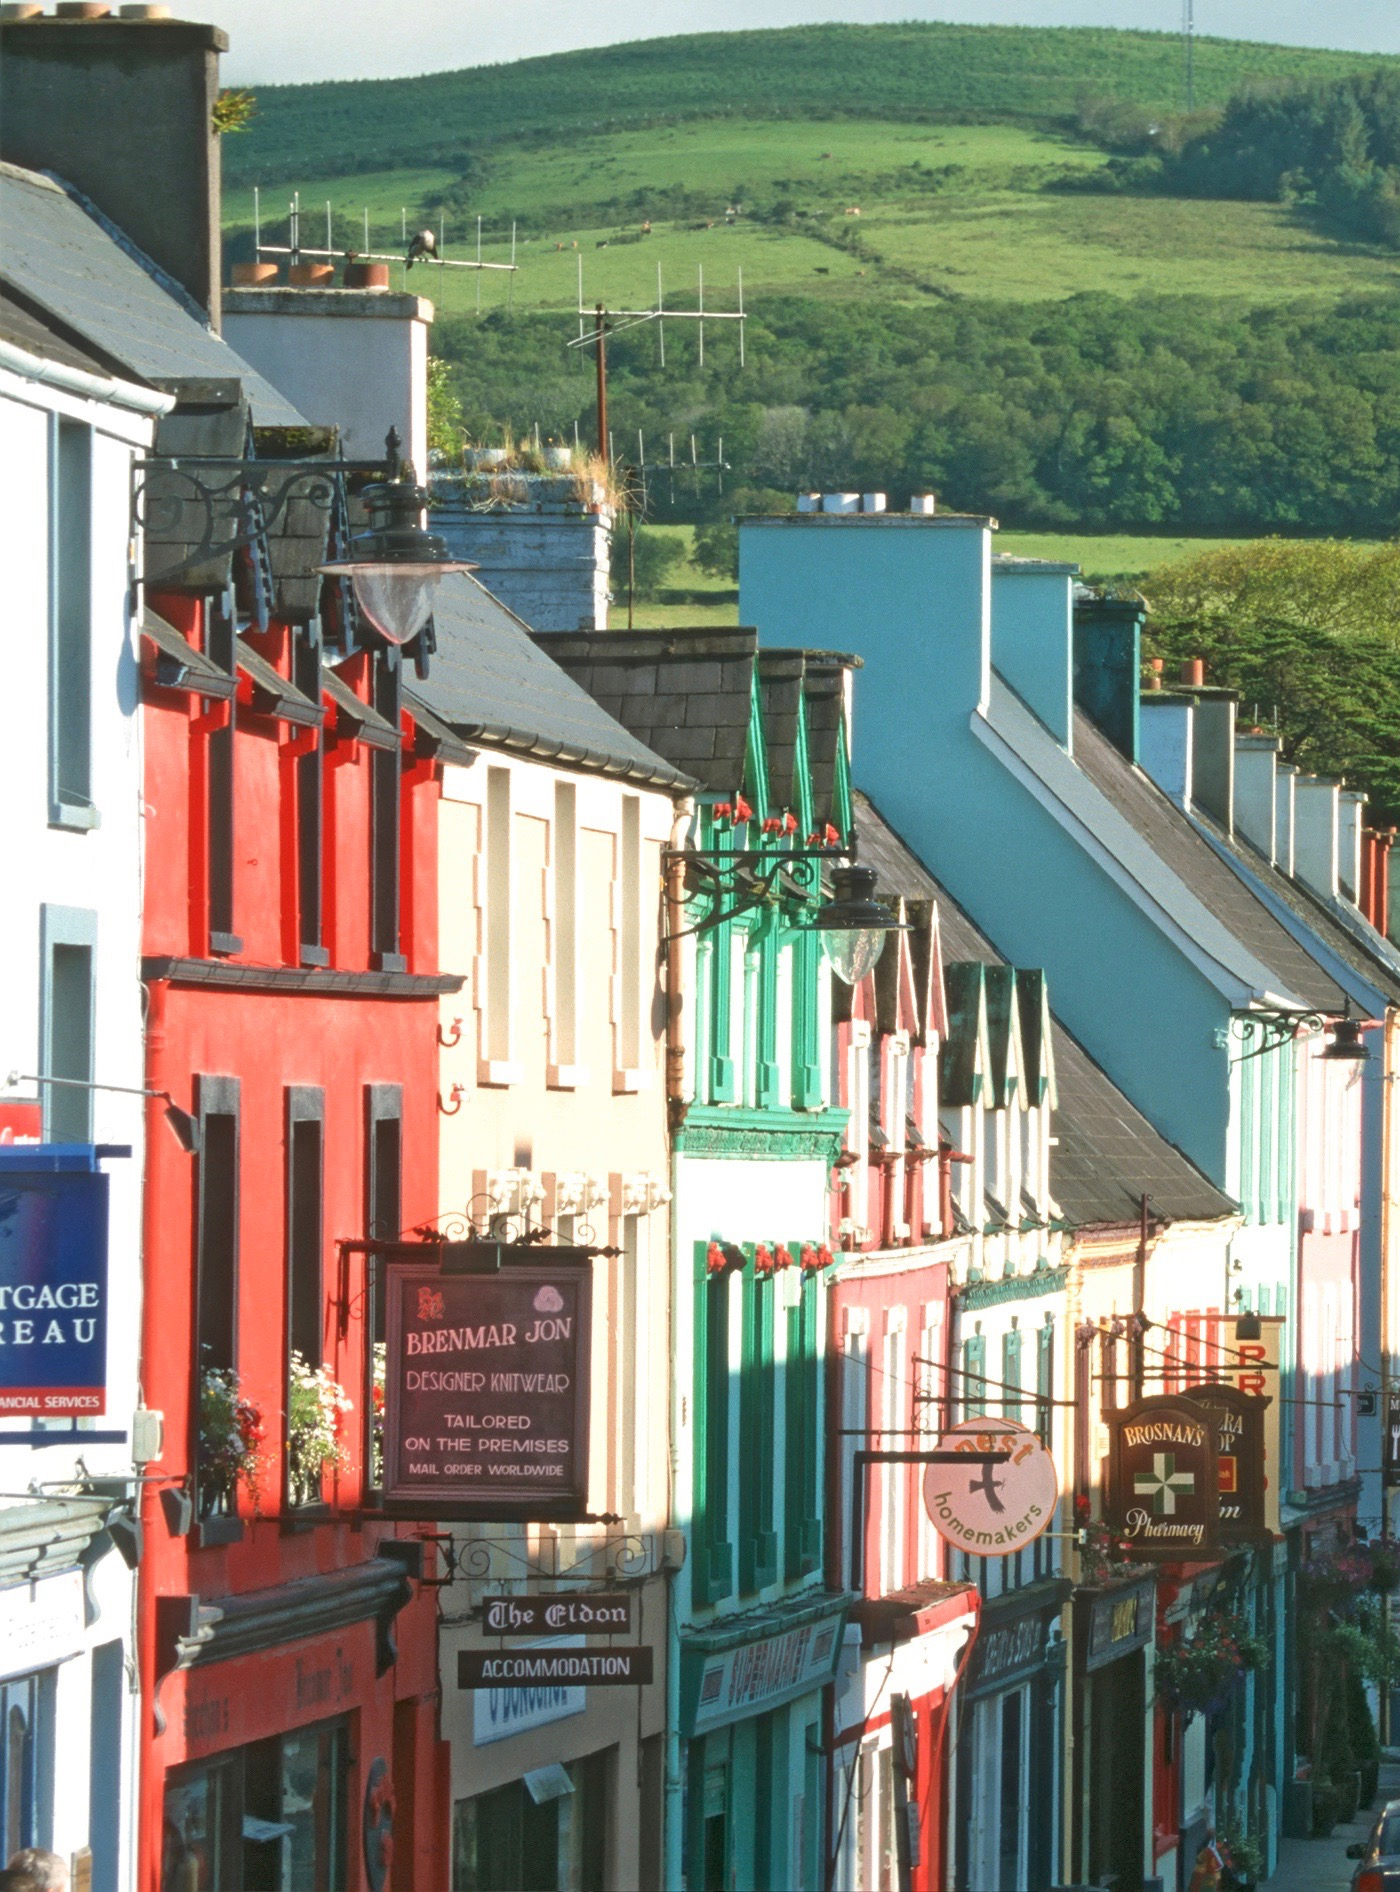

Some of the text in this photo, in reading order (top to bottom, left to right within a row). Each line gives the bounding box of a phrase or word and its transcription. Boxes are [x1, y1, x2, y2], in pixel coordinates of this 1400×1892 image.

[406, 1317, 572, 1355] BRENMAR JON
[406, 1370, 570, 1393] DESIGNER KNITWEAR
[45, 1395, 100, 1408] SERVICES
[444, 1414, 531, 1429] TAILORED
[405, 1437, 569, 1453] ON THE PREMISES
[1124, 1422, 1204, 1448] BROSNAN'S
[409, 1463, 564, 1477] MAIL ORDER WORLDWIDE
[933, 1490, 1043, 1546] homemakers
[1123, 1507, 1204, 1546] Pharmacy
[488, 1601, 627, 1629] The Eldon
[482, 1656, 630, 1678] ACCOMMODATION
